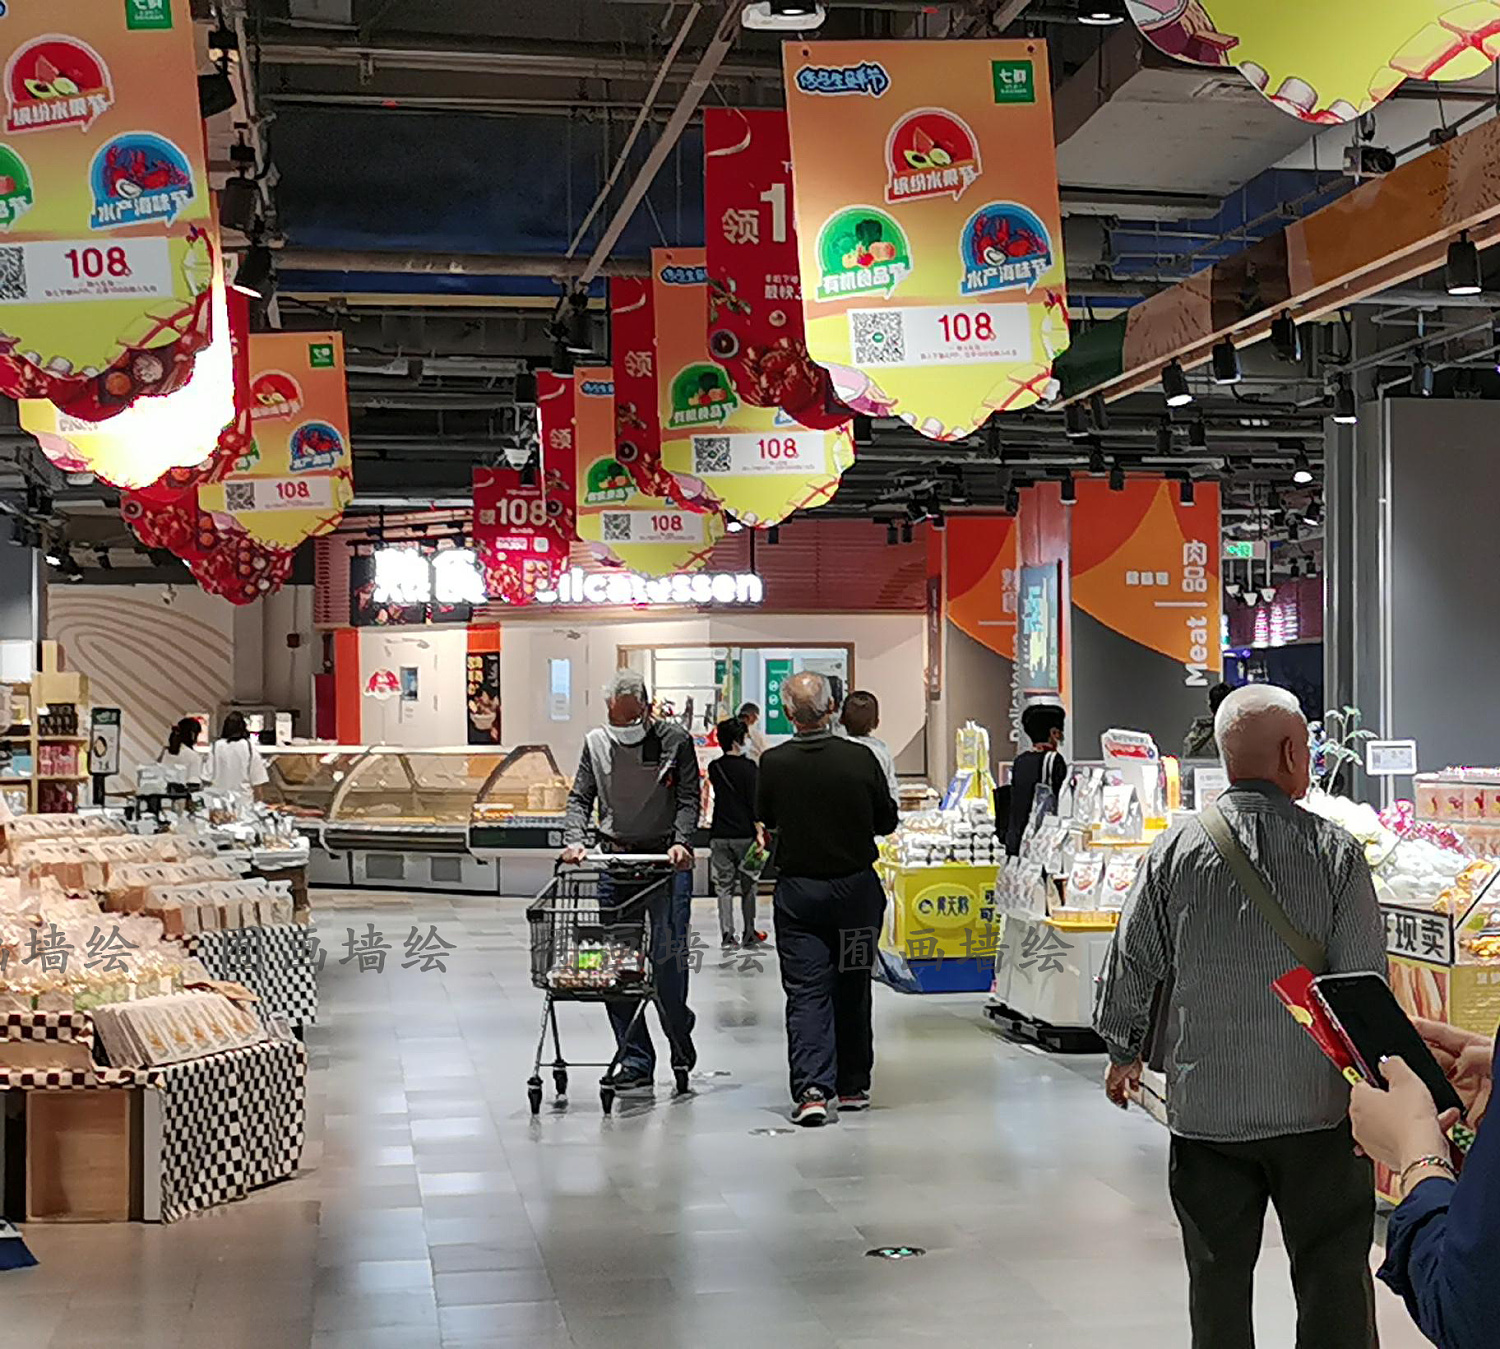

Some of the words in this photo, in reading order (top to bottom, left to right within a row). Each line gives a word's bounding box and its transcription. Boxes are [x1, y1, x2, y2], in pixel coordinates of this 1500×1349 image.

[722, 207, 760, 246] 领
[64, 246, 127, 279] 108
[822, 262, 905, 295] 有机食品节
[937, 311, 993, 343] 108
[756, 437, 799, 460] 108
[275, 481, 311, 500] 108
[495, 497, 547, 526] 108
[650, 514, 684, 532] 108
[1182, 539, 1208, 593] 肉品
[1186, 615, 1208, 687] Meat
